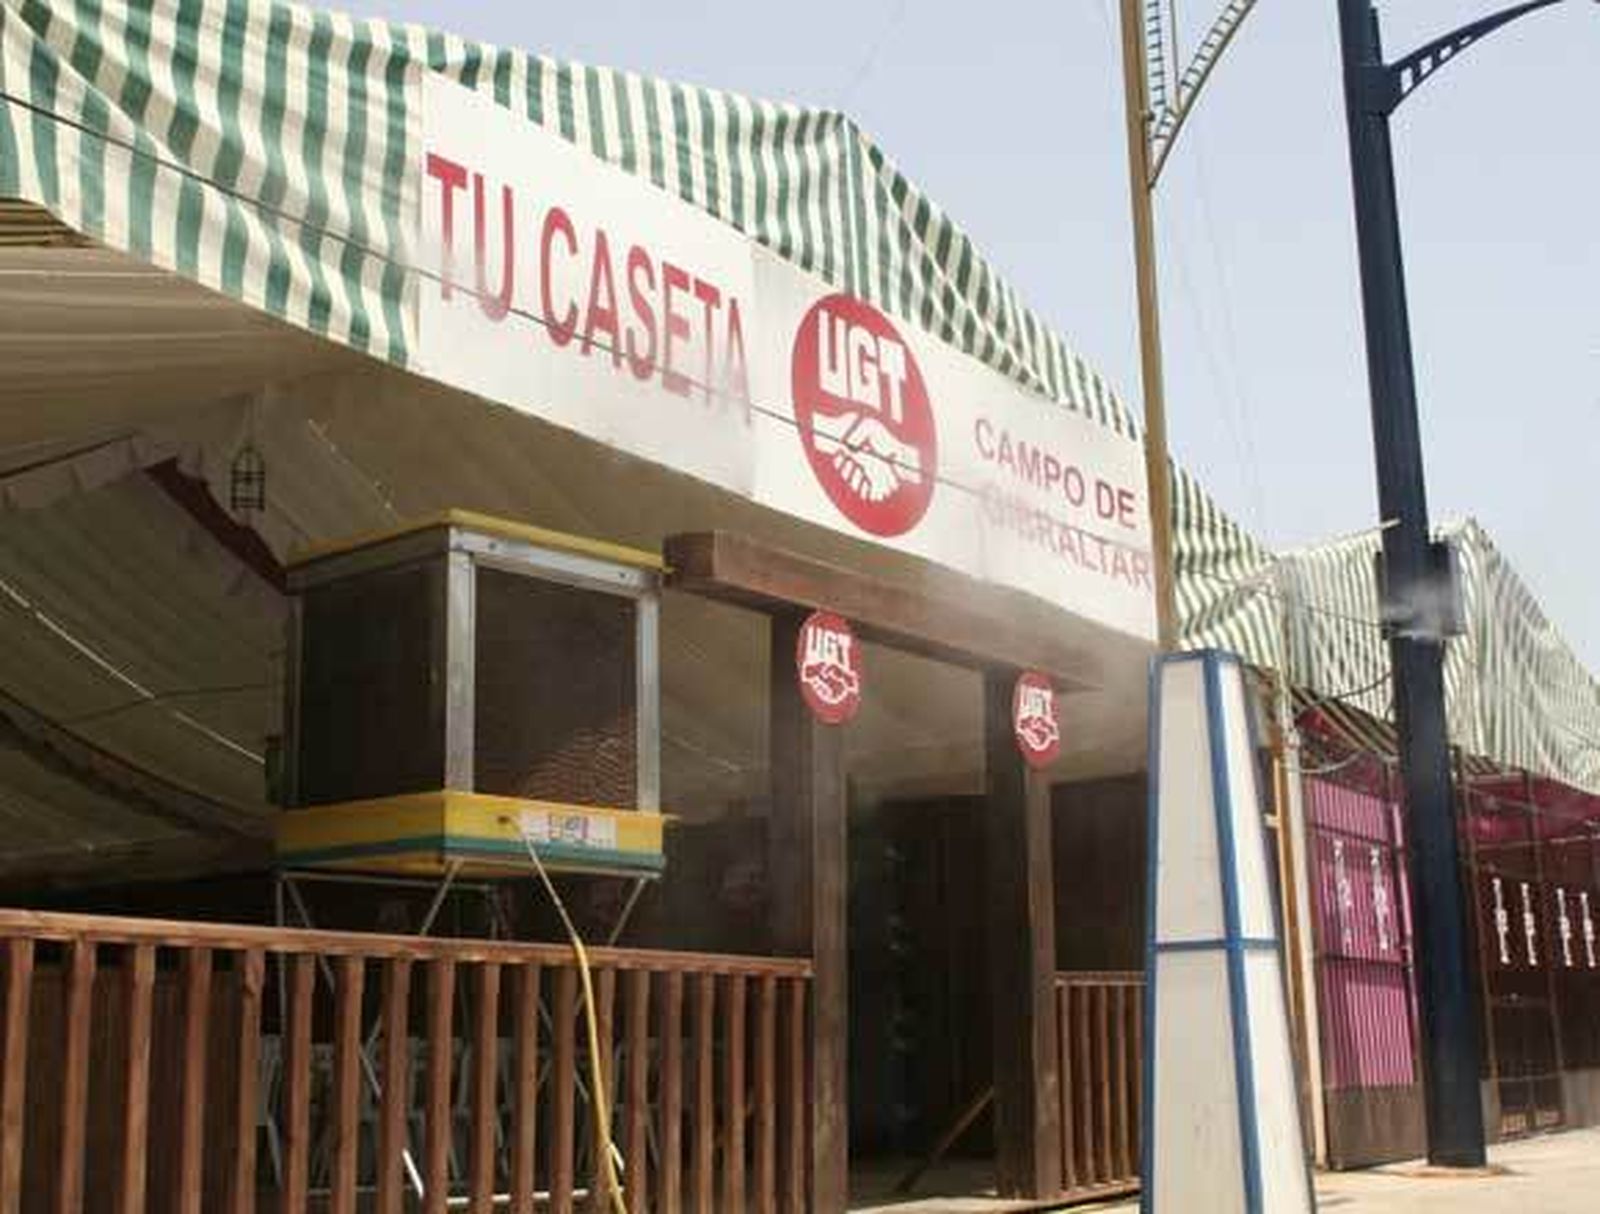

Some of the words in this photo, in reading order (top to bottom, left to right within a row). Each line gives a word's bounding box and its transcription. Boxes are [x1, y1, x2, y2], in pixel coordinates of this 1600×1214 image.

[426, 152, 514, 321] TU
[540, 207, 752, 425] CASETA
[818, 309, 907, 425] UGT
[974, 418, 1084, 507] CAMPO
[1095, 481, 1137, 530] DE
[806, 626, 851, 673] UGT
[1020, 684, 1052, 722] UGT
